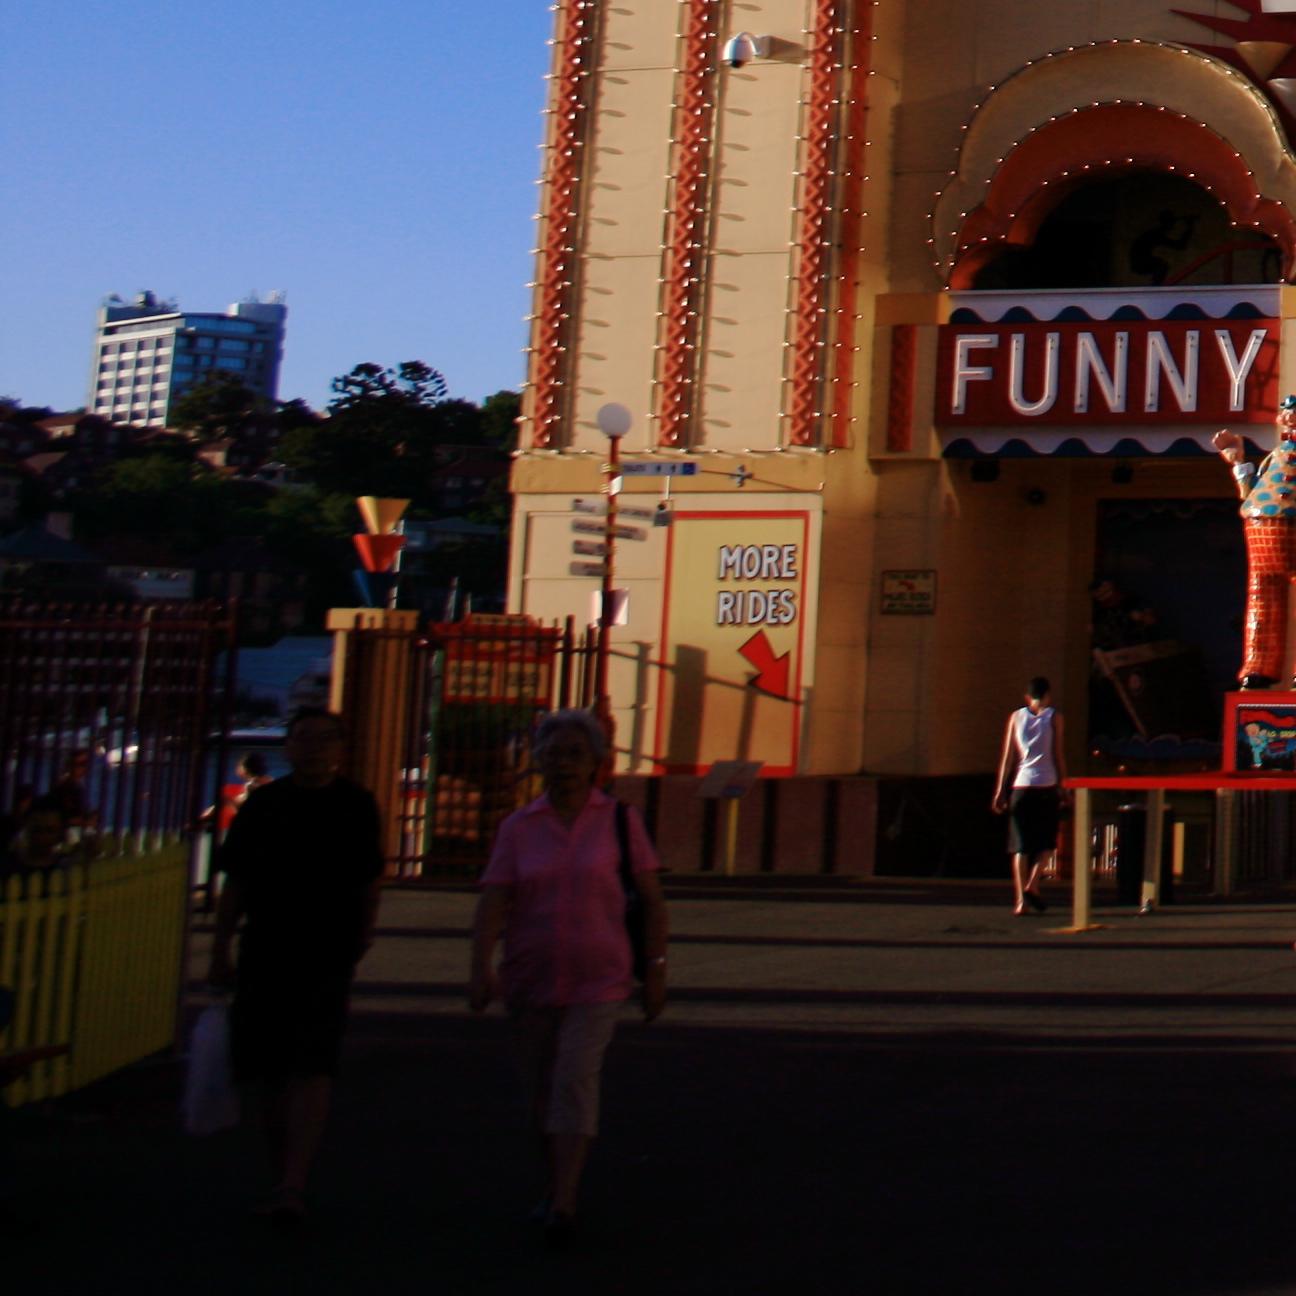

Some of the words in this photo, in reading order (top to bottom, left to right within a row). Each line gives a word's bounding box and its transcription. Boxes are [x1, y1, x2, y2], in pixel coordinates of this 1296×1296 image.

[951, 328, 1268, 415] FUNNY
[717, 543, 798, 580] MORE
[716, 589, 797, 626] RIDES
